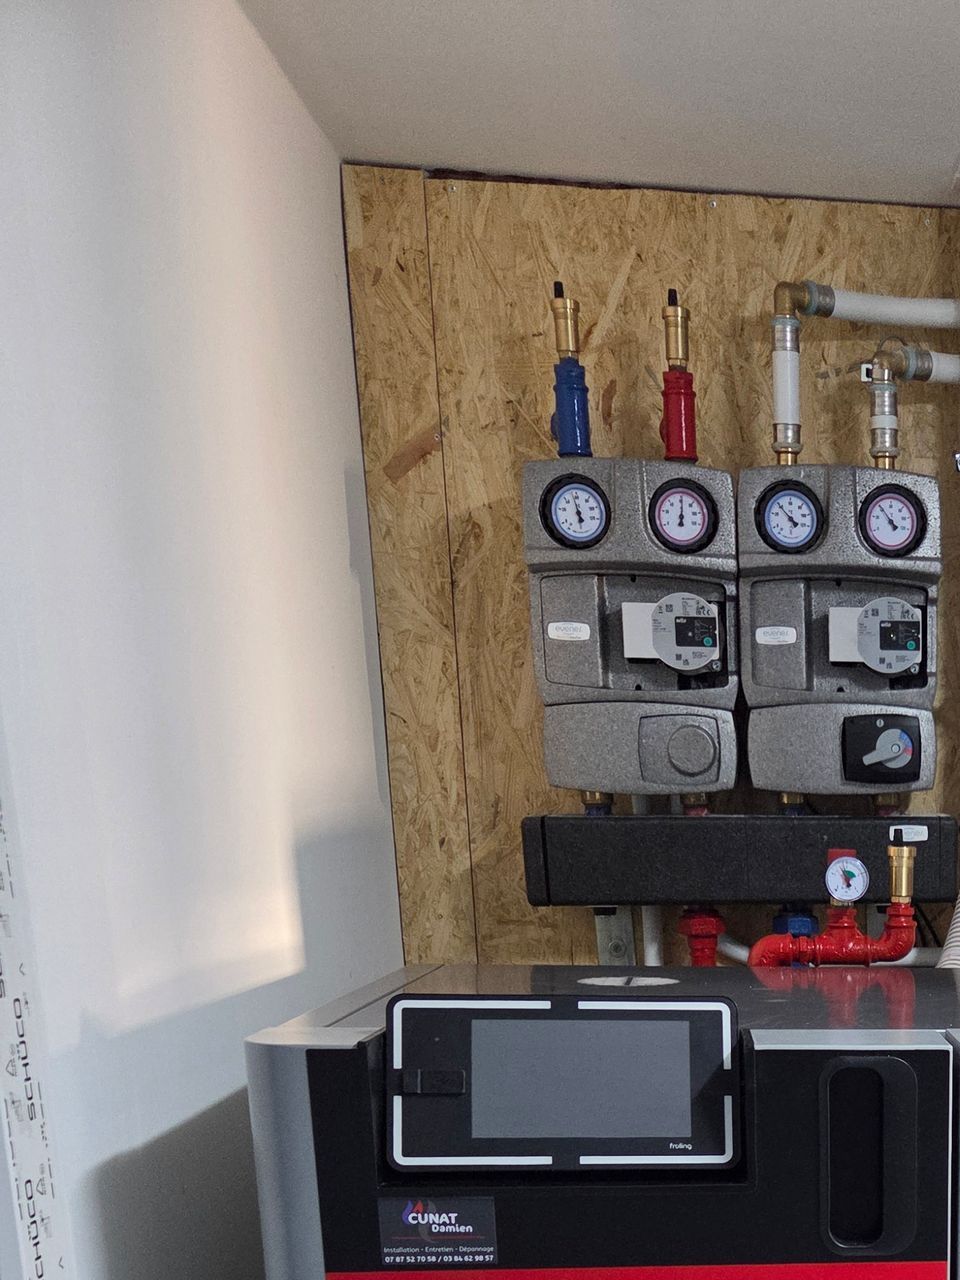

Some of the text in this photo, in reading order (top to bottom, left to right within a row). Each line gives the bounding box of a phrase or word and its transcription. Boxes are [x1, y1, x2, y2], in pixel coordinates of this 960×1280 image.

[13, 998, 36, 1121] SCHÜCO
[408, 1213, 458, 1224] CUNAT
[431, 1224, 473, 1233] Damien
[406, 1255, 415, 1263] 52
[464, 1254, 473, 1262] 62
[485, 1254, 494, 1262] 57
